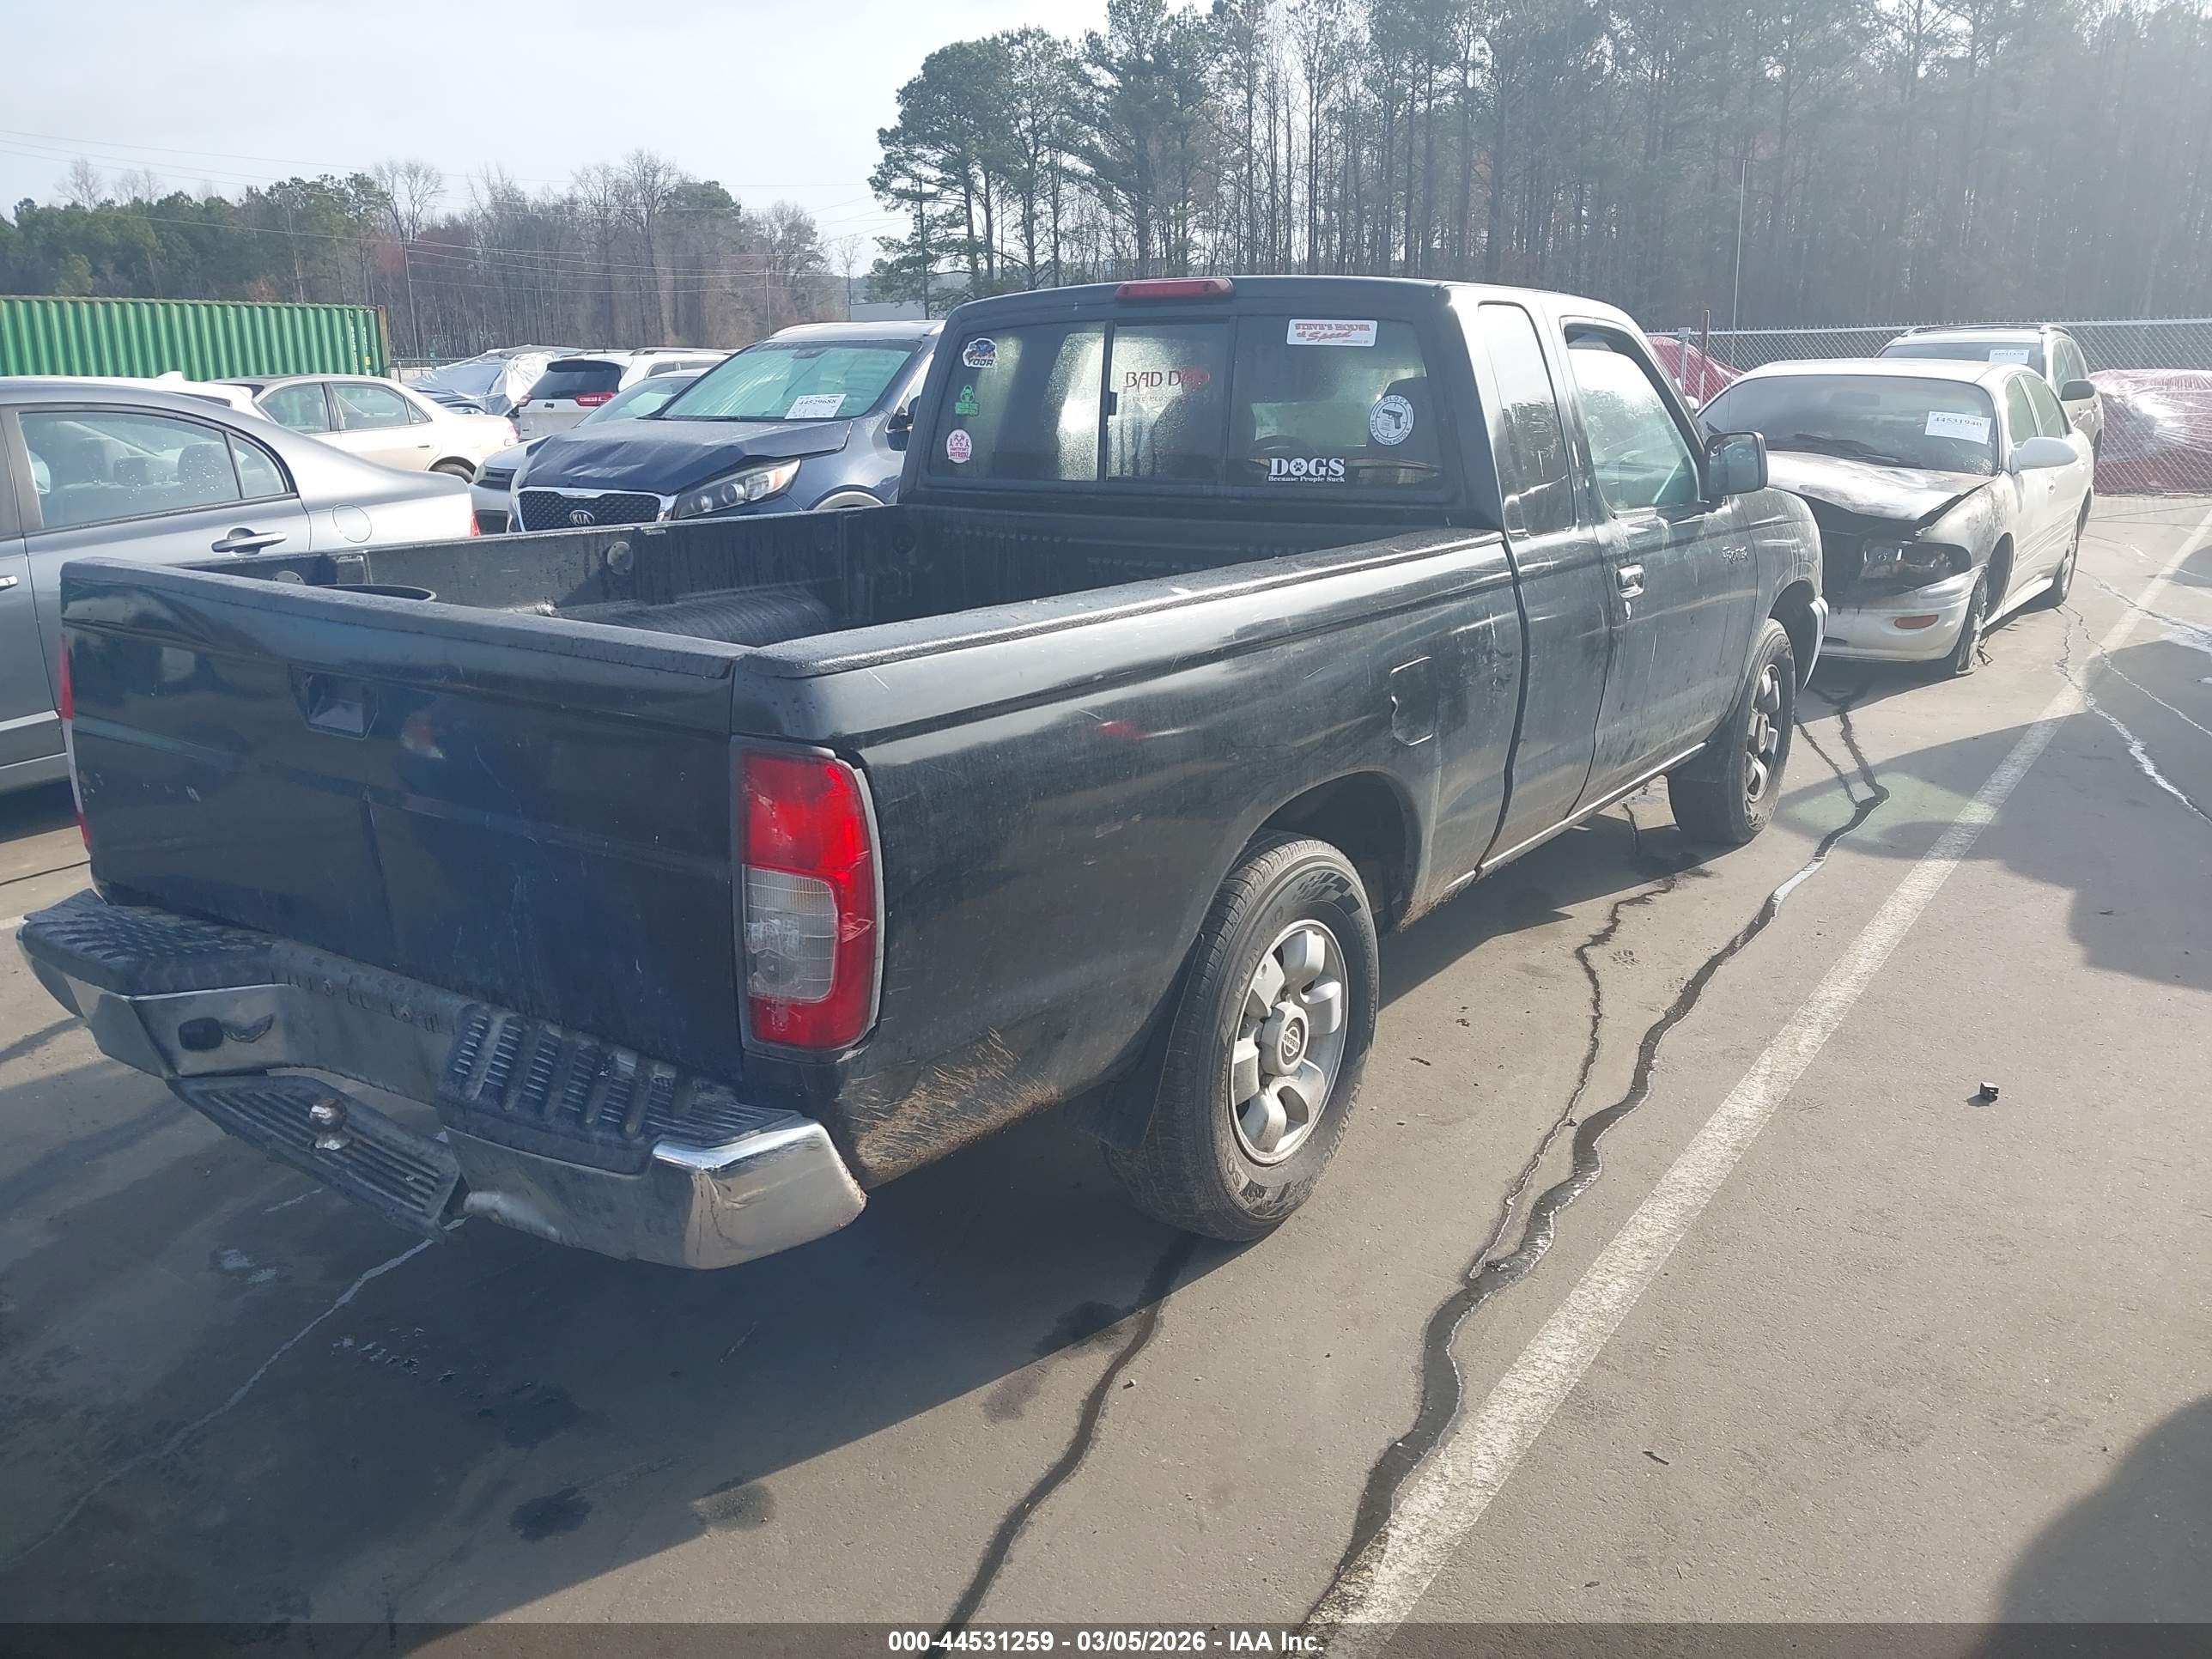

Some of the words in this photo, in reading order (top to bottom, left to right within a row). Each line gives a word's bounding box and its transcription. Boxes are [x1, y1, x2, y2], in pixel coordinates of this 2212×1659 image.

[1123, 371, 1163, 393] BAD
[1383, 396, 1408, 408] GLOCK
[1268, 457, 1345, 477] DOGS
